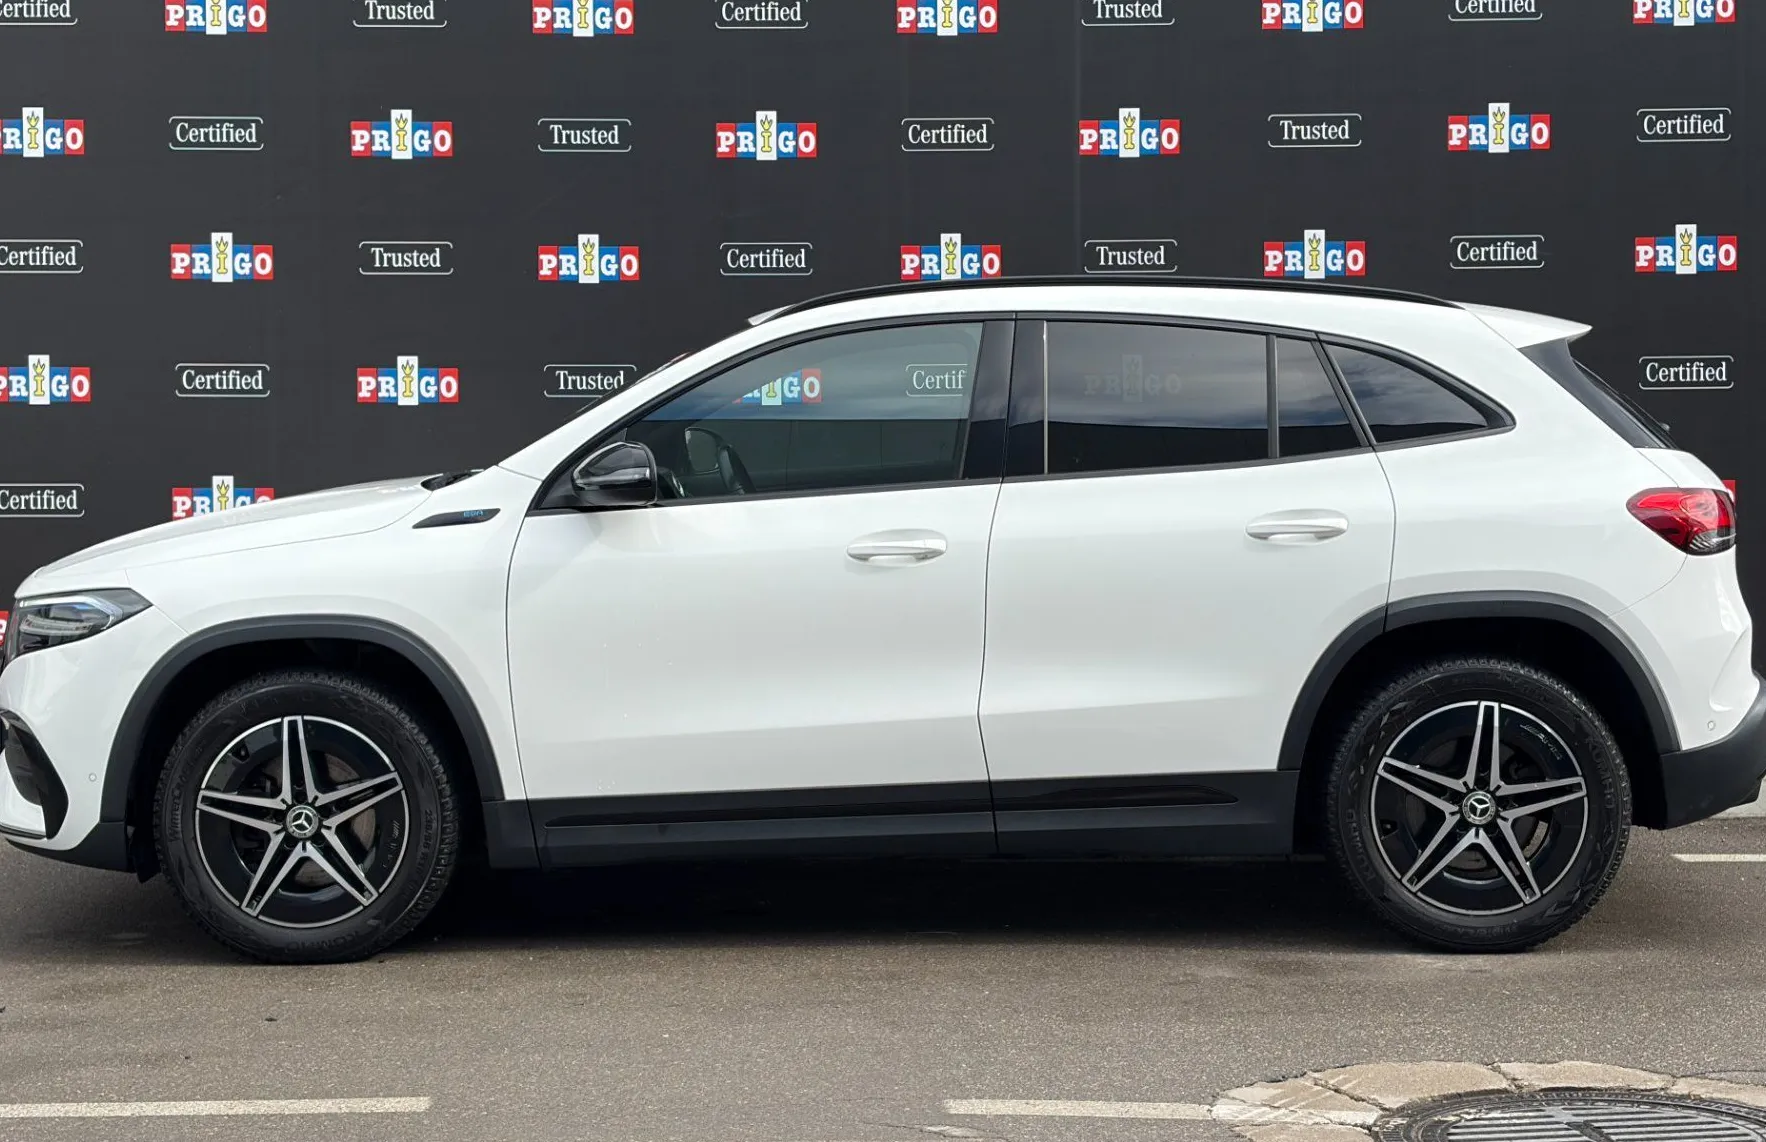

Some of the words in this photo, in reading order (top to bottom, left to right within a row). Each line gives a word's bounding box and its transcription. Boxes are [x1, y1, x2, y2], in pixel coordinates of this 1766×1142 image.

[167, 0, 266, 27] PRIGO
[365, 0, 434, 19] Trusted
[534, 0, 632, 28] PRIGO
[722, 1, 801, 21] Certified
[898, 0, 997, 27] PRIGO
[1093, 0, 1162, 18] Trusted
[1263, 0, 1362, 25] PRIGO
[1455, 0, 1535, 14] Certified
[1634, 0, 1734, 19] PRIGO
[2, 110, 83, 150] RIGO
[176, 122, 257, 143] Certified
[353, 114, 452, 151] PRIGO
[550, 125, 619, 144] Trusted
[718, 115, 816, 152] PRIGO
[909, 124, 987, 143] Certified
[1080, 112, 1179, 149] PRIGO
[1280, 120, 1349, 139] Trusted
[1449, 107, 1548, 144] PRIGO
[1644, 114, 1724, 134] Certified
[0, 246, 76, 266] Certified
[172, 236, 271, 273] PRIGO
[539, 238, 638, 275] PRIGO
[902, 238, 1000, 275] PRIGO
[1096, 246, 1165, 265] Trusted
[1265, 233, 1364, 270] PRIGO
[1457, 241, 1537, 261] Certified
[1636, 228, 1735, 265] PRIGO
[371, 248, 441, 267] Trusted
[727, 249, 806, 268] Certified
[182, 369, 263, 389] Certified
[359, 360, 457, 397] PRIGO
[556, 370, 624, 390] Trusted
[913, 369, 966, 390] Certif
[1084, 357, 1182, 395] PRIGO
[1646, 362, 1727, 382] Certified
[743, 376, 820, 399] IGO
[0, 490, 77, 510] Certified
[173, 479, 272, 517] PRI
